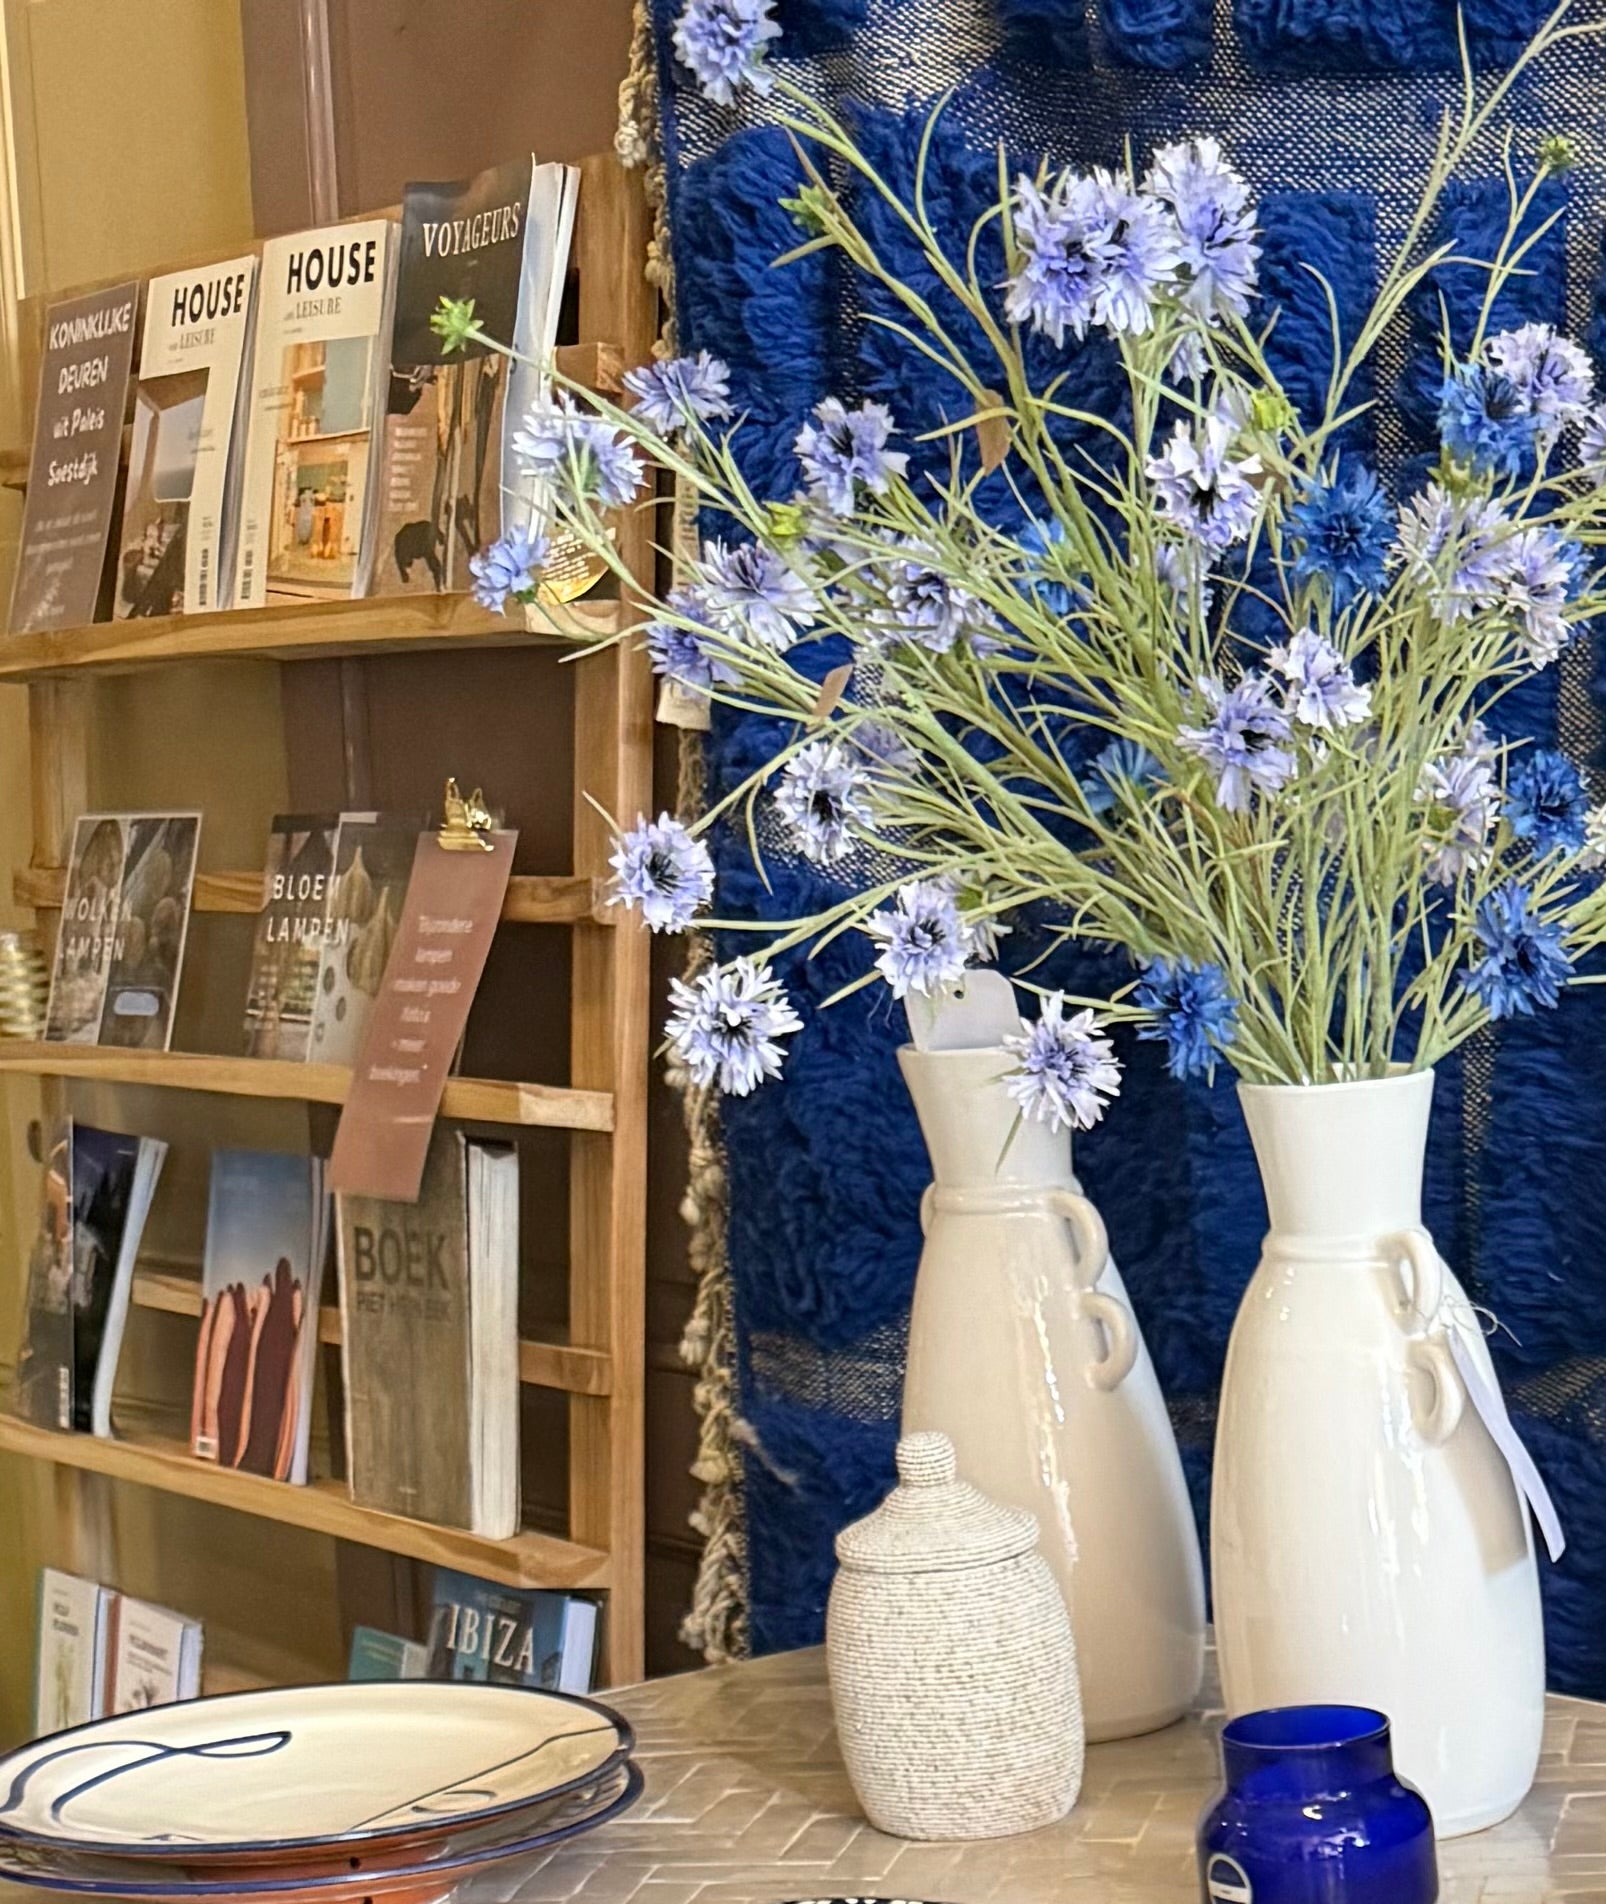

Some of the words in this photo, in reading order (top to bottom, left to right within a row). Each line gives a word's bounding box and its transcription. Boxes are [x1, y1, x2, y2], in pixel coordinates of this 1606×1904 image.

[422, 202, 521, 258] VOYAGEURS
[287, 240, 377, 295] HOUSE
[171, 273, 245, 327] HOUSE
[296, 296, 342, 319] LEISURE
[49, 302, 132, 350] KONINKLIJKE
[180, 327, 216, 349] LEISURE
[58, 355, 109, 394] DEUREN
[70, 407, 105, 436] Paleis
[47, 451, 98, 487] Soestdijk
[266, 917, 349, 944] LAMPEN
[354, 1226, 448, 1290] BOEK
[446, 1602, 534, 1674] IBIZA
